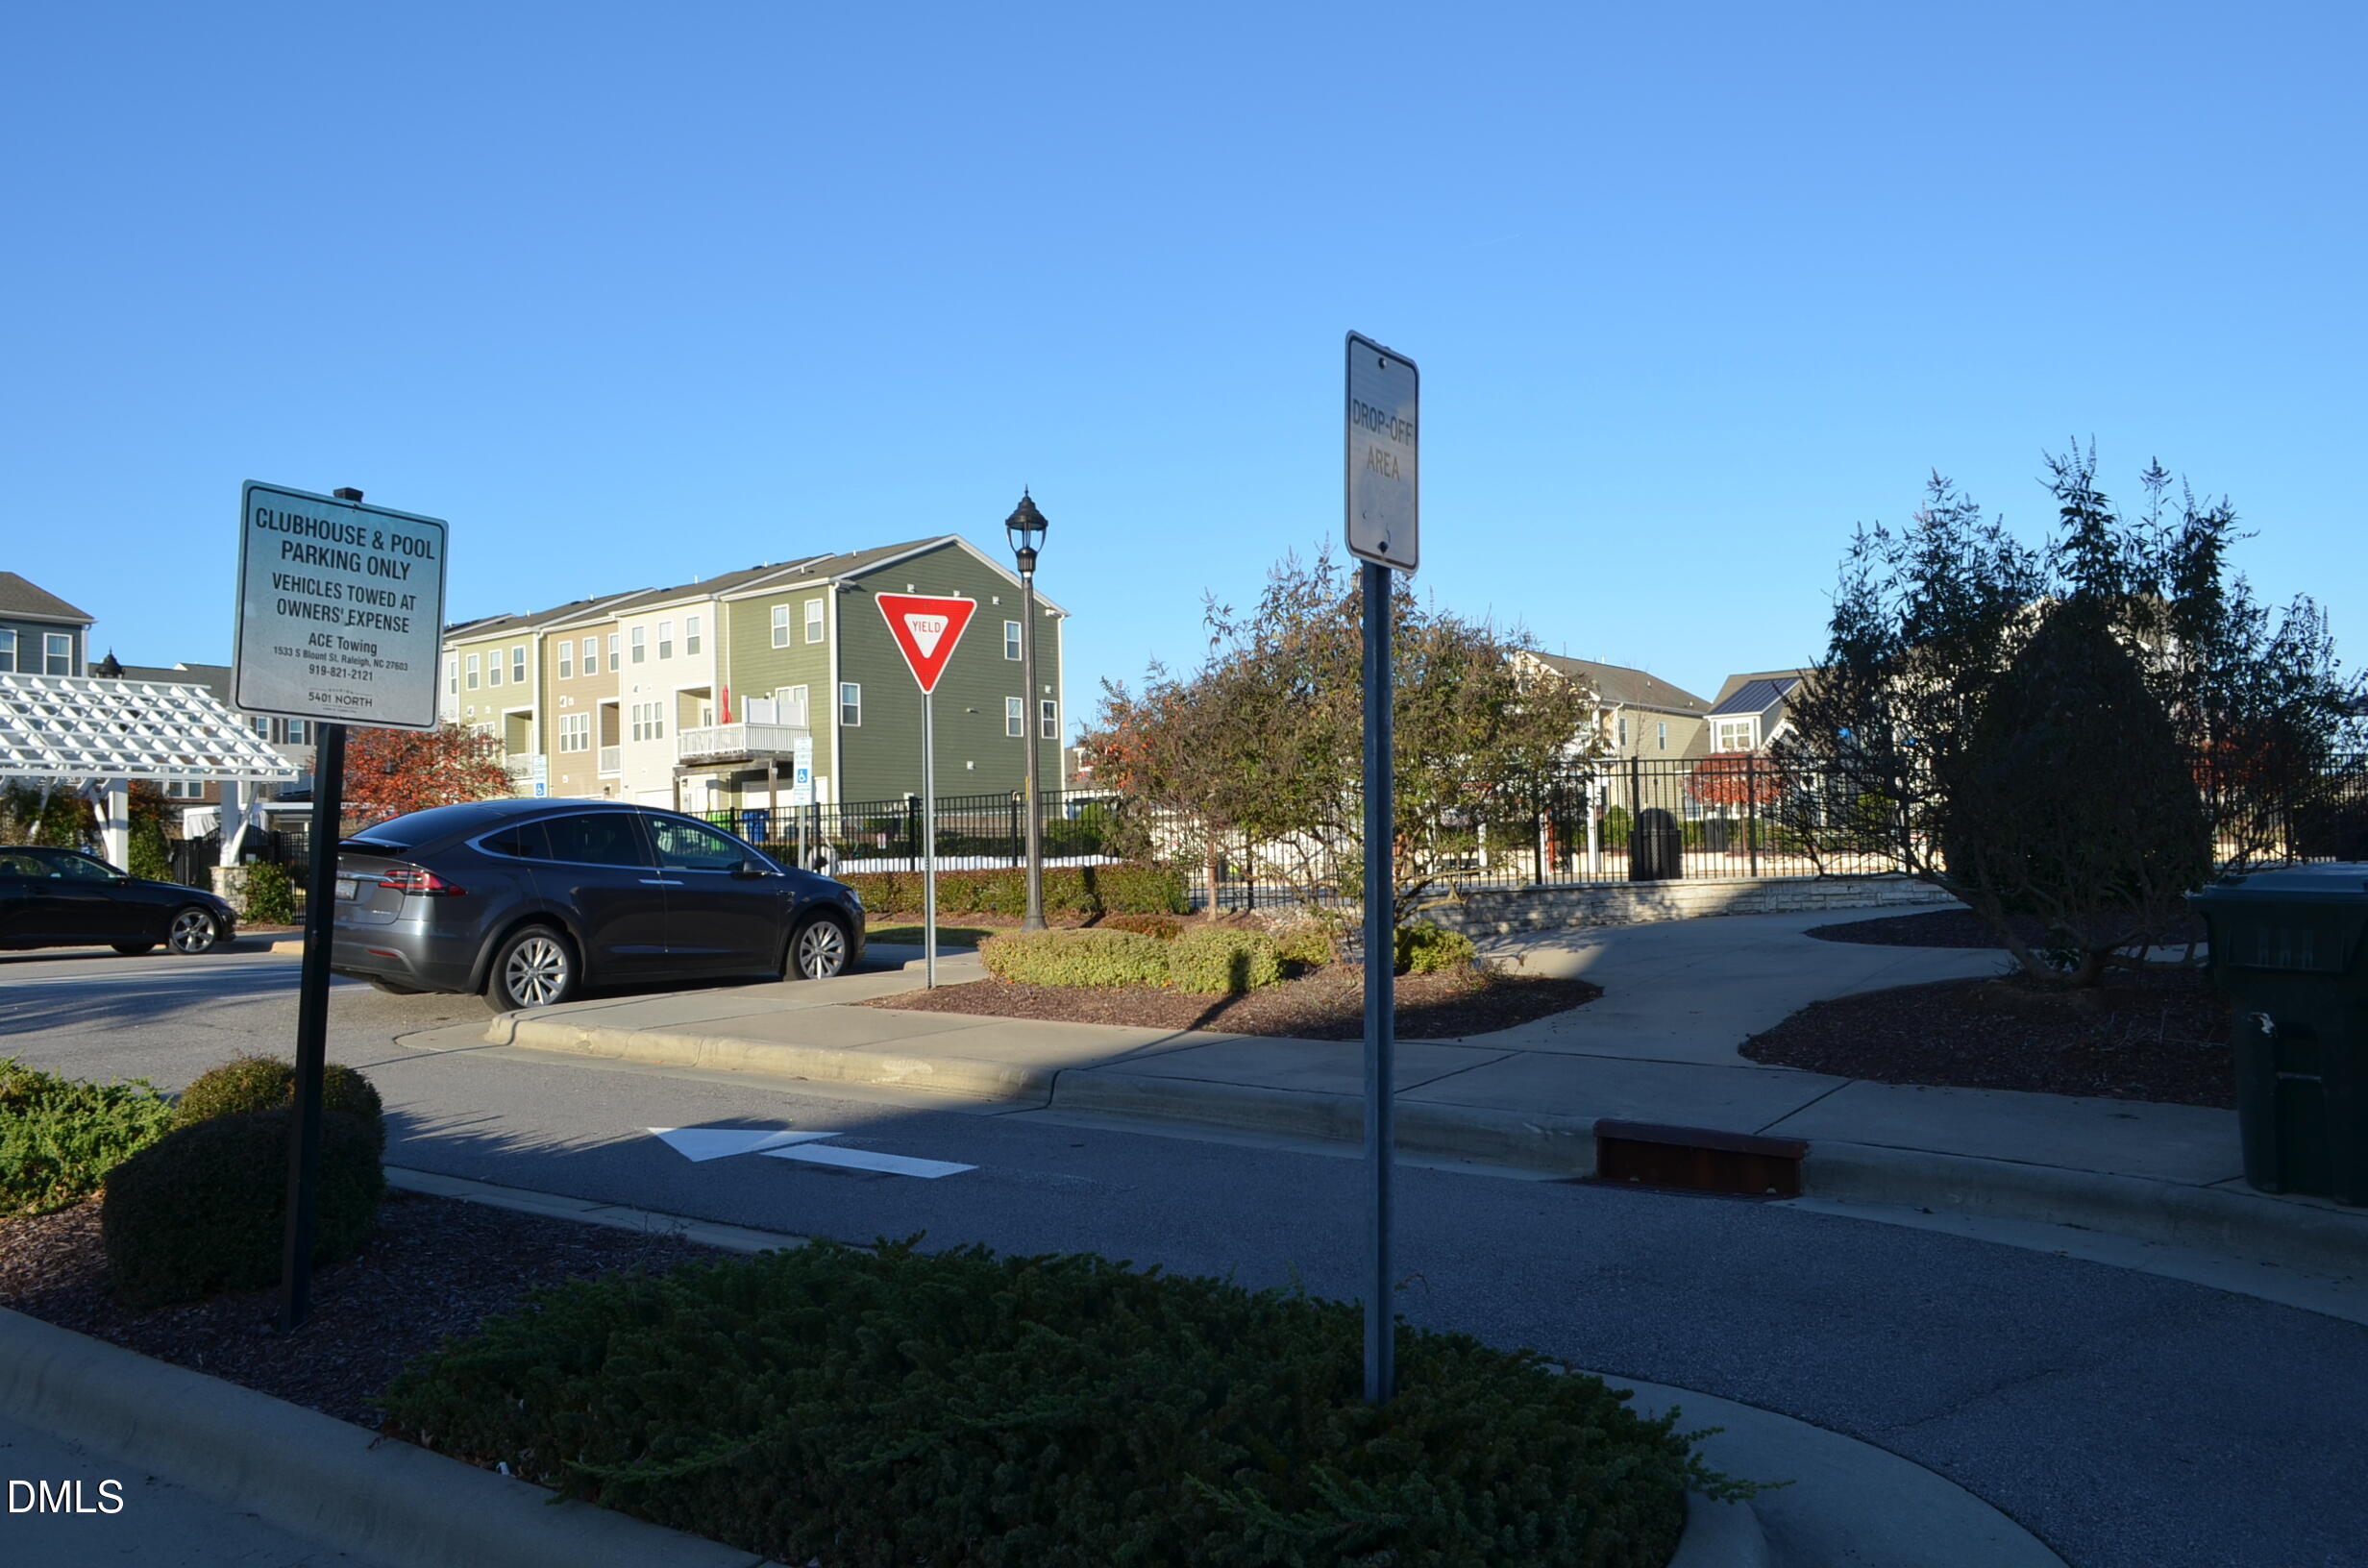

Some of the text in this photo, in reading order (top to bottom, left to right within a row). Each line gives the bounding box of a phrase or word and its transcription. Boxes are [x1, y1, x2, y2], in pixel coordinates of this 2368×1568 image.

[1352, 398, 1413, 446] DROP-OFF
[1367, 445, 1400, 480] AREA
[256, 507, 435, 560] CLUBHOUSE & POOL
[281, 541, 411, 581] PARKING ONLY
[272, 573, 417, 611] VEHICLES TOWED AT
[277, 599, 409, 633] OWNERS' EXPENSE
[912, 621, 941, 633] YIELD
[274, 646, 293, 657] 1533
[295, 649, 301, 658] S
[303, 649, 327, 661] Blount
[373, 658, 384, 669] NC
[308, 632, 378, 657] ACE Towing
[308, 664, 373, 681] 919-821-2121
[308, 691, 332, 703] 5401
[335, 695, 373, 707] NORTH
